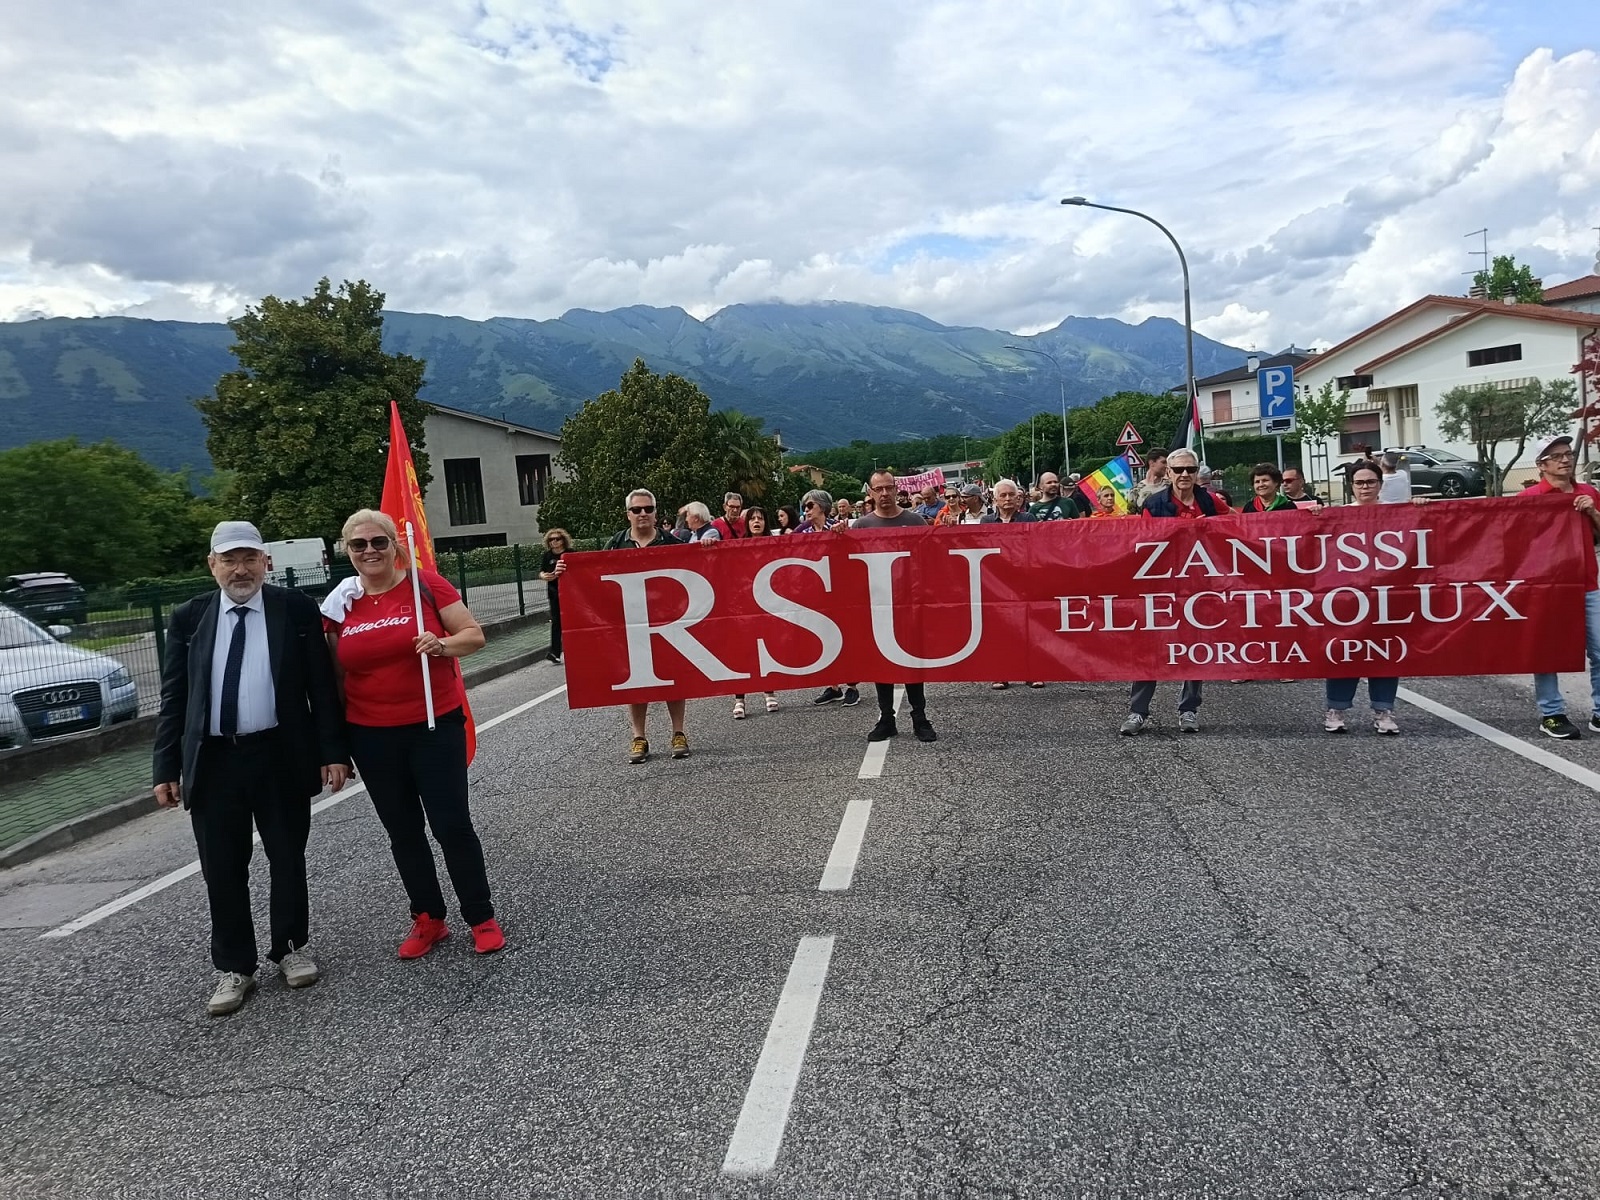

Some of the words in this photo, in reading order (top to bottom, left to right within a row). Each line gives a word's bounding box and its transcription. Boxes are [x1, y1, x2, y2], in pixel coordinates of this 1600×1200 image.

[1265, 370, 1286, 395] P
[1132, 528, 1435, 580] ZANUSSI
[600, 547, 1002, 691] RSU
[1054, 579, 1528, 633] ELECTROLUX
[1166, 641, 1311, 666] PORCIA
[1325, 635, 1408, 665] (PN)
